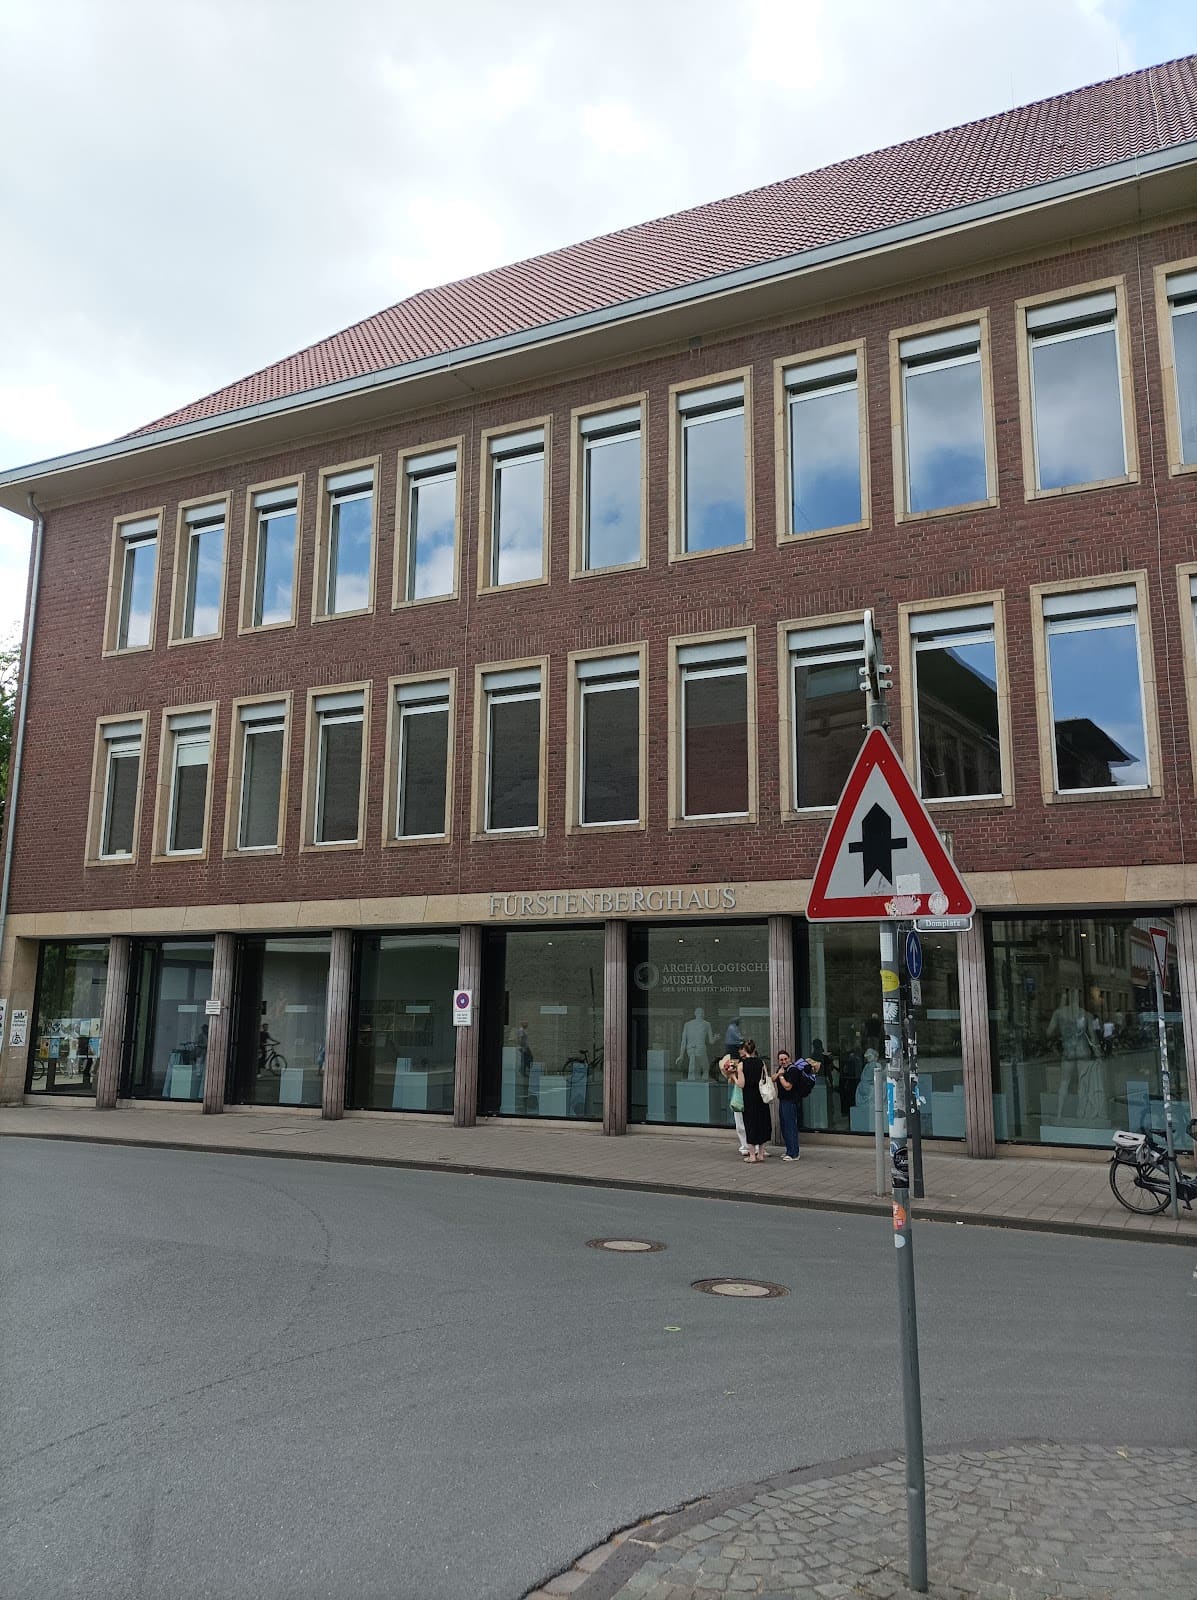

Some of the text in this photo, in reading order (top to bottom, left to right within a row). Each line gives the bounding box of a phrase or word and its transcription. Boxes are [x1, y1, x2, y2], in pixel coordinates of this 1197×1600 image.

[489, 887, 737, 916] FÜRSTENBERGHAUS
[925, 919, 961, 928] Domplatz
[662, 975, 714, 985] MUSEUM
